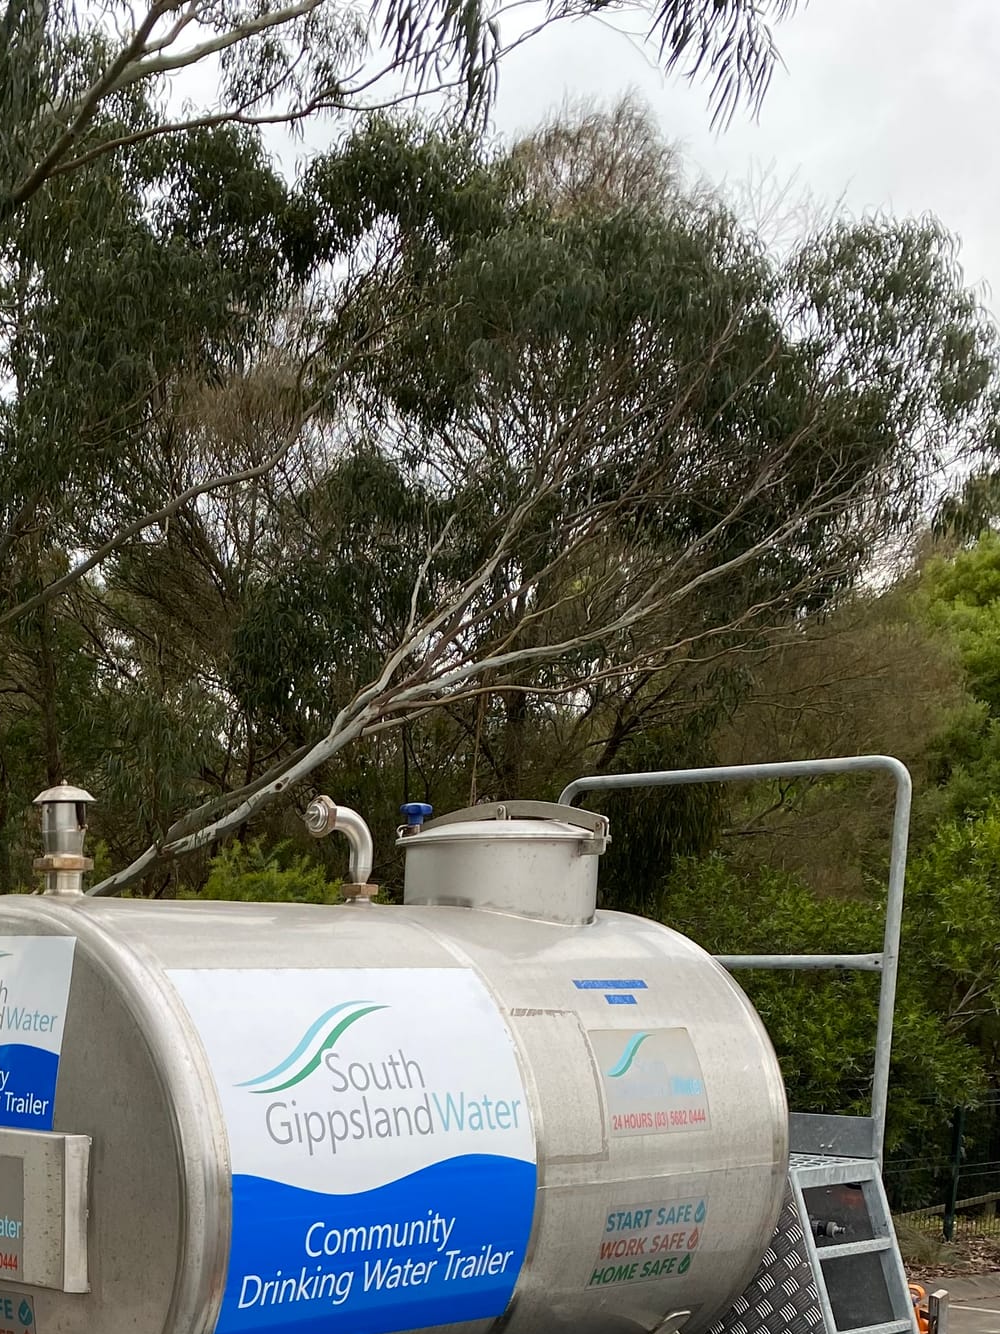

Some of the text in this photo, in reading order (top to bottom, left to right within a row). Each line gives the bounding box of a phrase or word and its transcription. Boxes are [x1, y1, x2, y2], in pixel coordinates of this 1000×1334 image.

[324, 1049, 425, 1093] South
[5, 1092, 49, 1116] Trailer
[612, 1108, 706, 1130] 24 HOURS (03) 5682 0444
[606, 1204, 692, 1232] START SAFE
[305, 1210, 456, 1258] Community
[600, 1232, 686, 1260] WORK SAFE
[237, 1244, 515, 1309] Drinking Water Trailer
[589, 1257, 678, 1286] HOME SAFE
